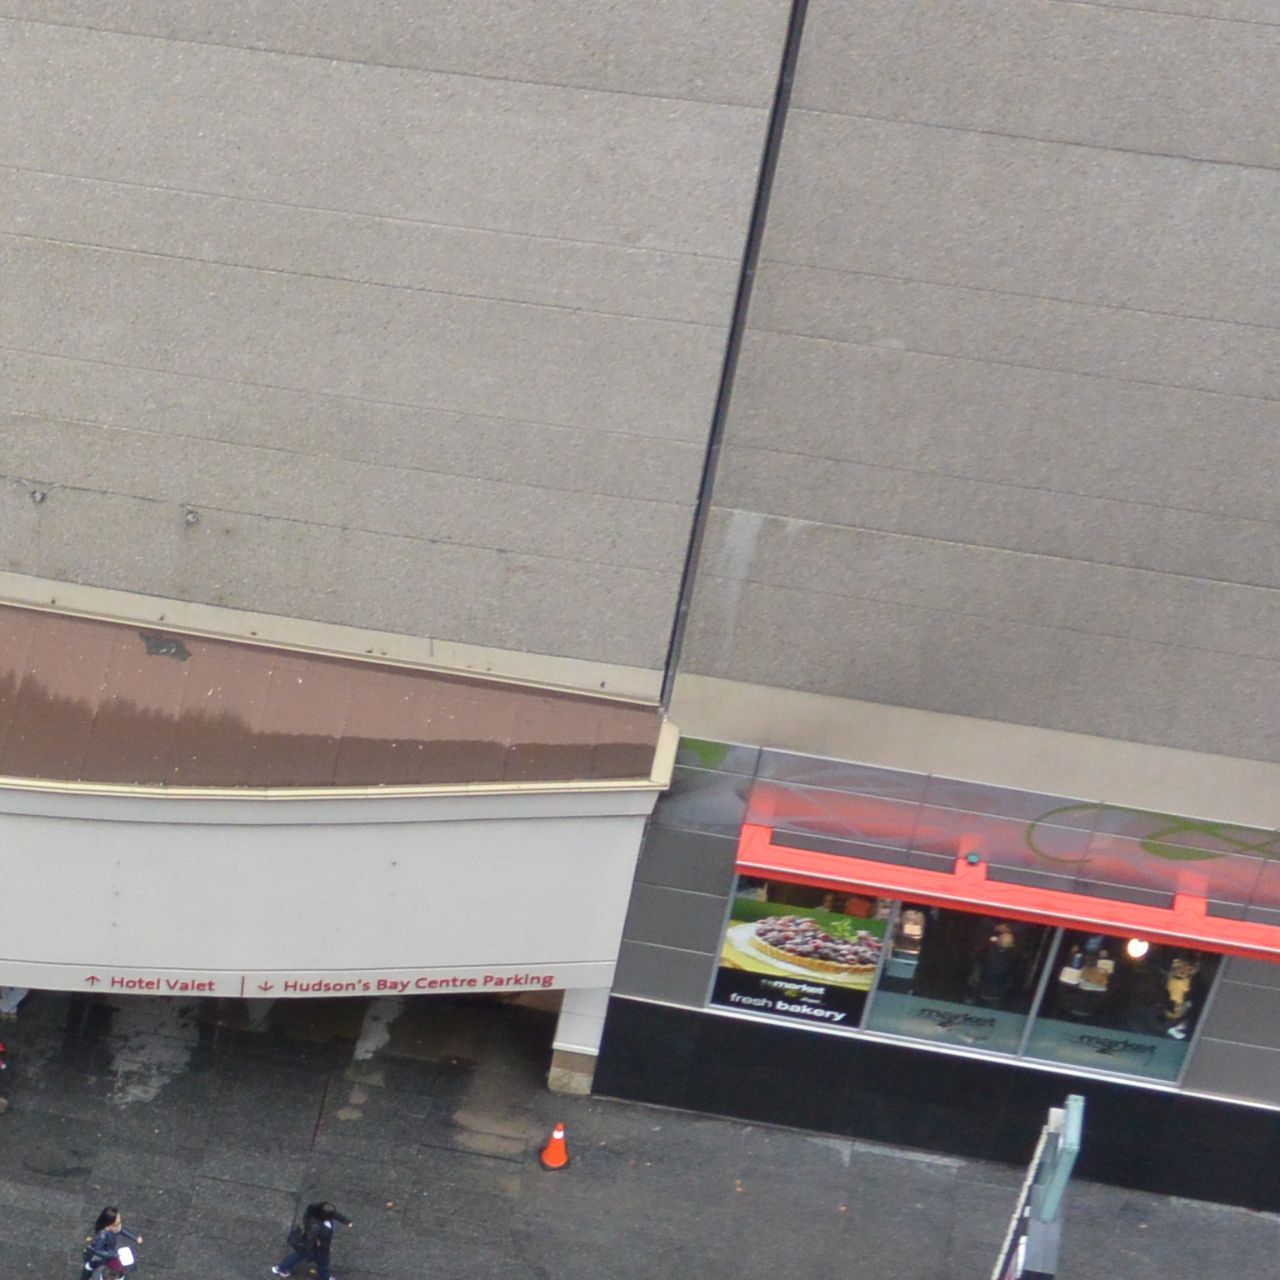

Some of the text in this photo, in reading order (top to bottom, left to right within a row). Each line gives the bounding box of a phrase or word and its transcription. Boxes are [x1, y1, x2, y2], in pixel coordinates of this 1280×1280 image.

[111, 976, 216, 992] Hotel Valet
[283, 973, 555, 993] Hudson's Bay Centre Parking
[772, 978, 826, 995] market
[729, 992, 773, 1008] fresh
[775, 1000, 847, 1022] bakery
